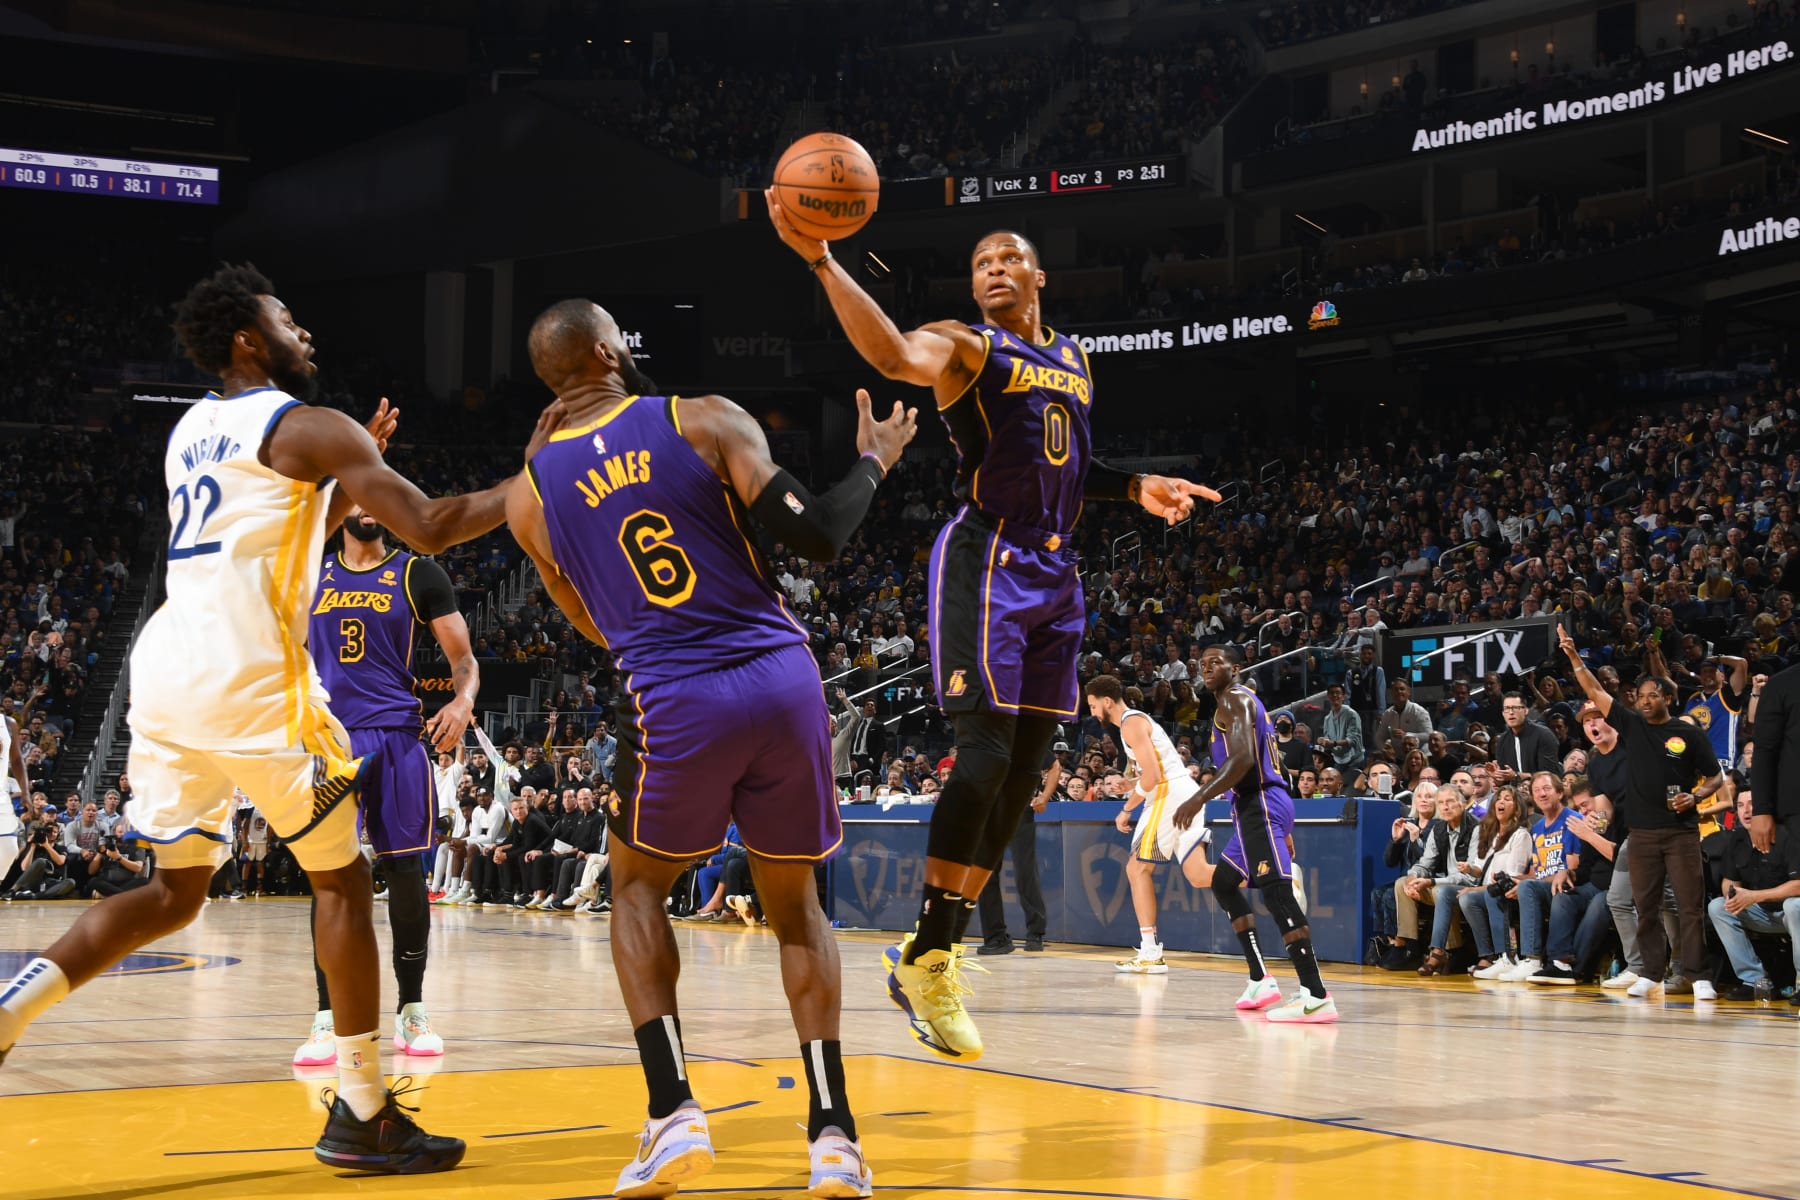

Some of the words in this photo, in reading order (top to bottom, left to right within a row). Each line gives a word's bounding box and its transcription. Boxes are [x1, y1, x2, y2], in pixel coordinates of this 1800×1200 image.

[1412, 107, 1537, 151] Authentic
[1543, 80, 1665, 127] Moments
[1673, 61, 1723, 95] Live
[1728, 40, 1794, 78] Here.
[15, 168, 46, 184] 60.9
[71, 173, 99, 189] 10.5
[123, 178, 150, 193] 38.1
[176, 182, 203, 198] 71.4
[19, 153, 45, 163] 2P%
[73, 158, 99, 168] 3P%
[126, 163, 152, 173] FG%
[179, 168, 203, 178] FT%
[994, 179, 1022, 191] VGK
[1029, 176, 1038, 190] 2
[1059, 173, 1087, 185] CGY
[1094, 170, 1103, 185] 3
[1117, 169, 1134, 180] P3
[1140, 165, 1166, 180] 2:51
[798, 192, 867, 219] Wilson
[1718, 217, 1800, 256] Authe
[1182, 322, 1228, 347] Live
[1233, 314, 1293, 340] Here.
[1001, 357, 1090, 405] LAKERS
[1044, 402, 1070, 466] 0
[575, 449, 651, 508] JAMES
[167, 474, 223, 561] 22
[617, 508, 697, 608] 6
[312, 588, 393, 616] LAKERS
[339, 618, 365, 663] 3
[1443, 630, 1524, 680] FTX
